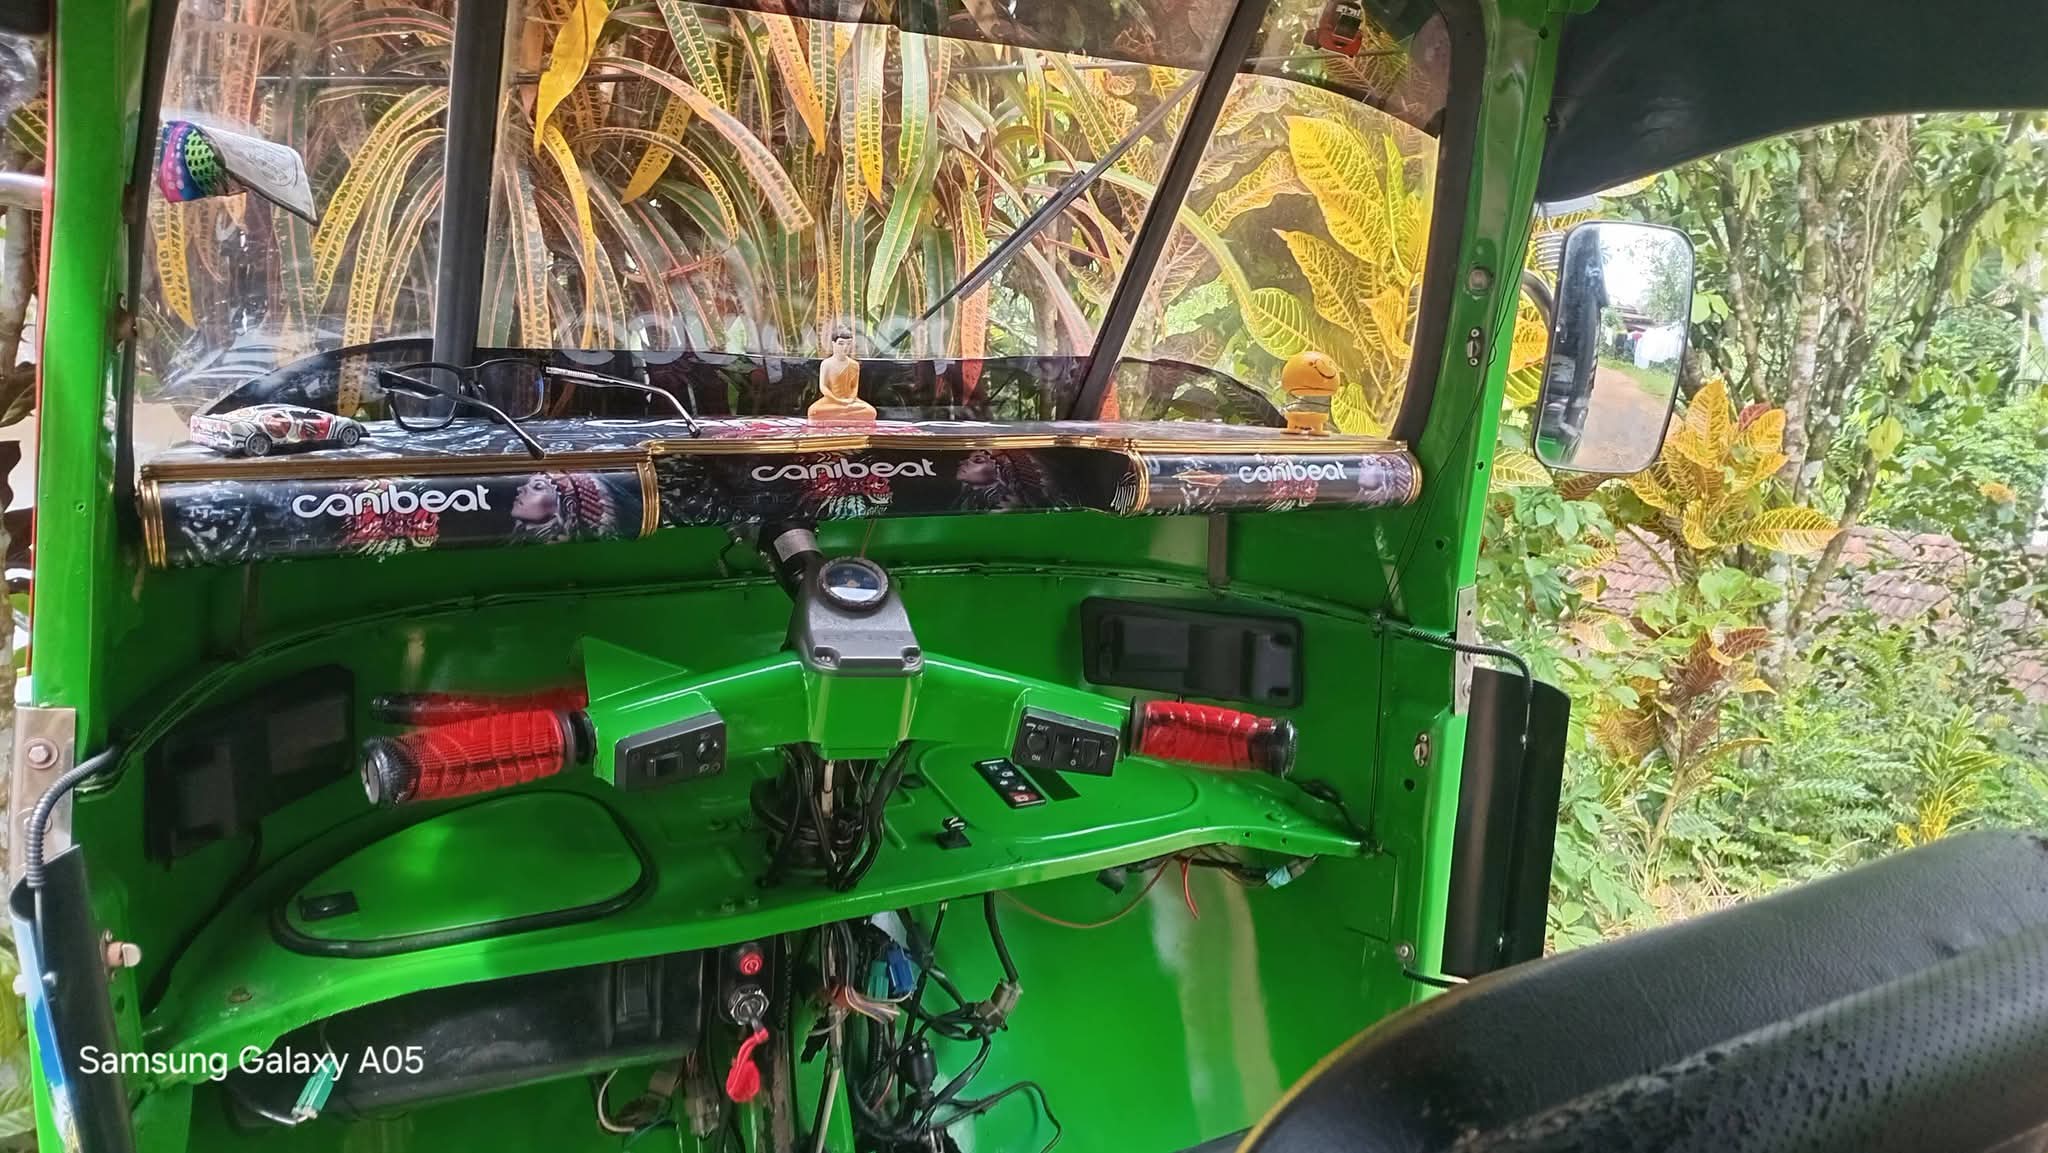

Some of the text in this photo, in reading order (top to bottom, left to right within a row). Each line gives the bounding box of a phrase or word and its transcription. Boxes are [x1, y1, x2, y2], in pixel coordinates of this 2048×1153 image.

[751, 458, 937, 482] canibeat
[1238, 461, 1348, 483] canibeat
[292, 484, 492, 518] canibeat
